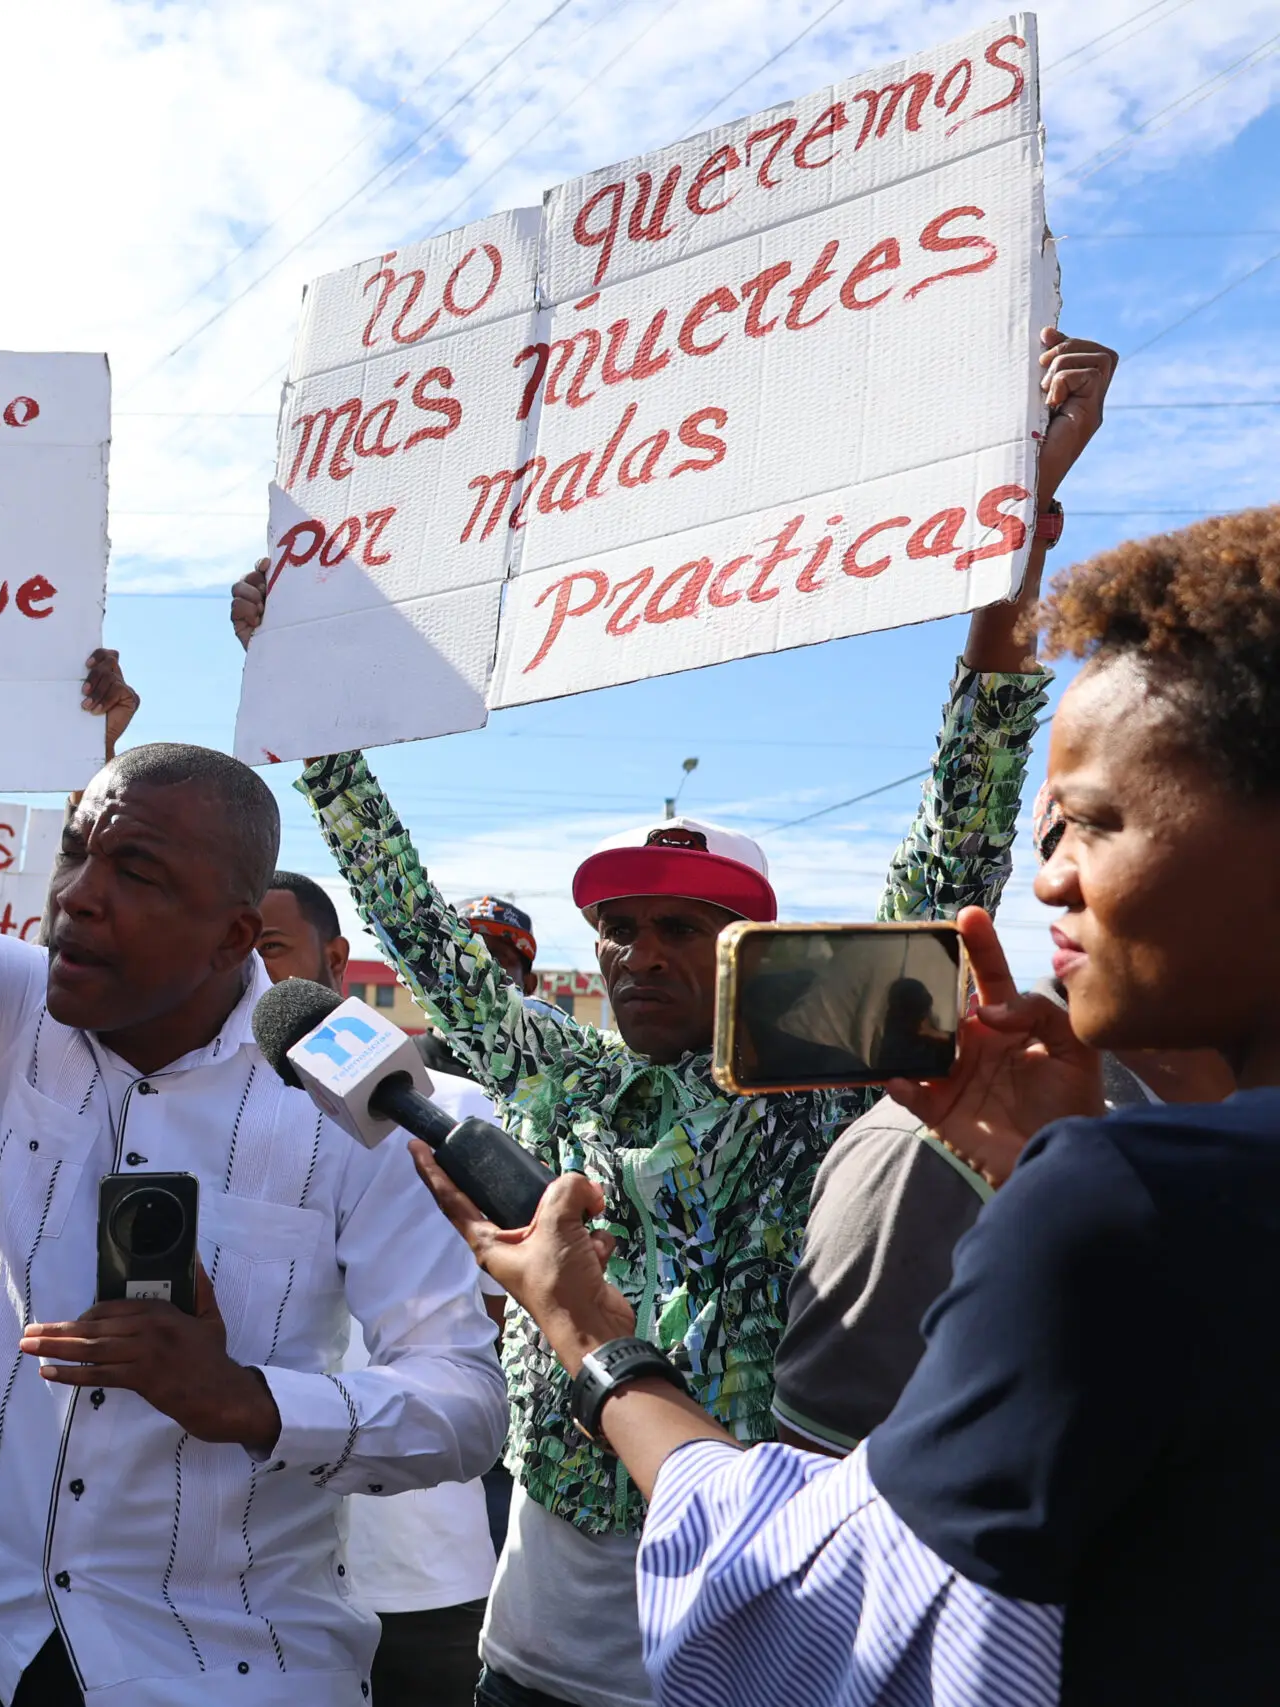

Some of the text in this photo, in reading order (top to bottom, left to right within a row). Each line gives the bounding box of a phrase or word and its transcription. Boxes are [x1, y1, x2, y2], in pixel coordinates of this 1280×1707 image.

[573, 33, 1026, 311] queremos
[285, 205, 999, 490] más muertes
[266, 403, 729, 595] por malas
